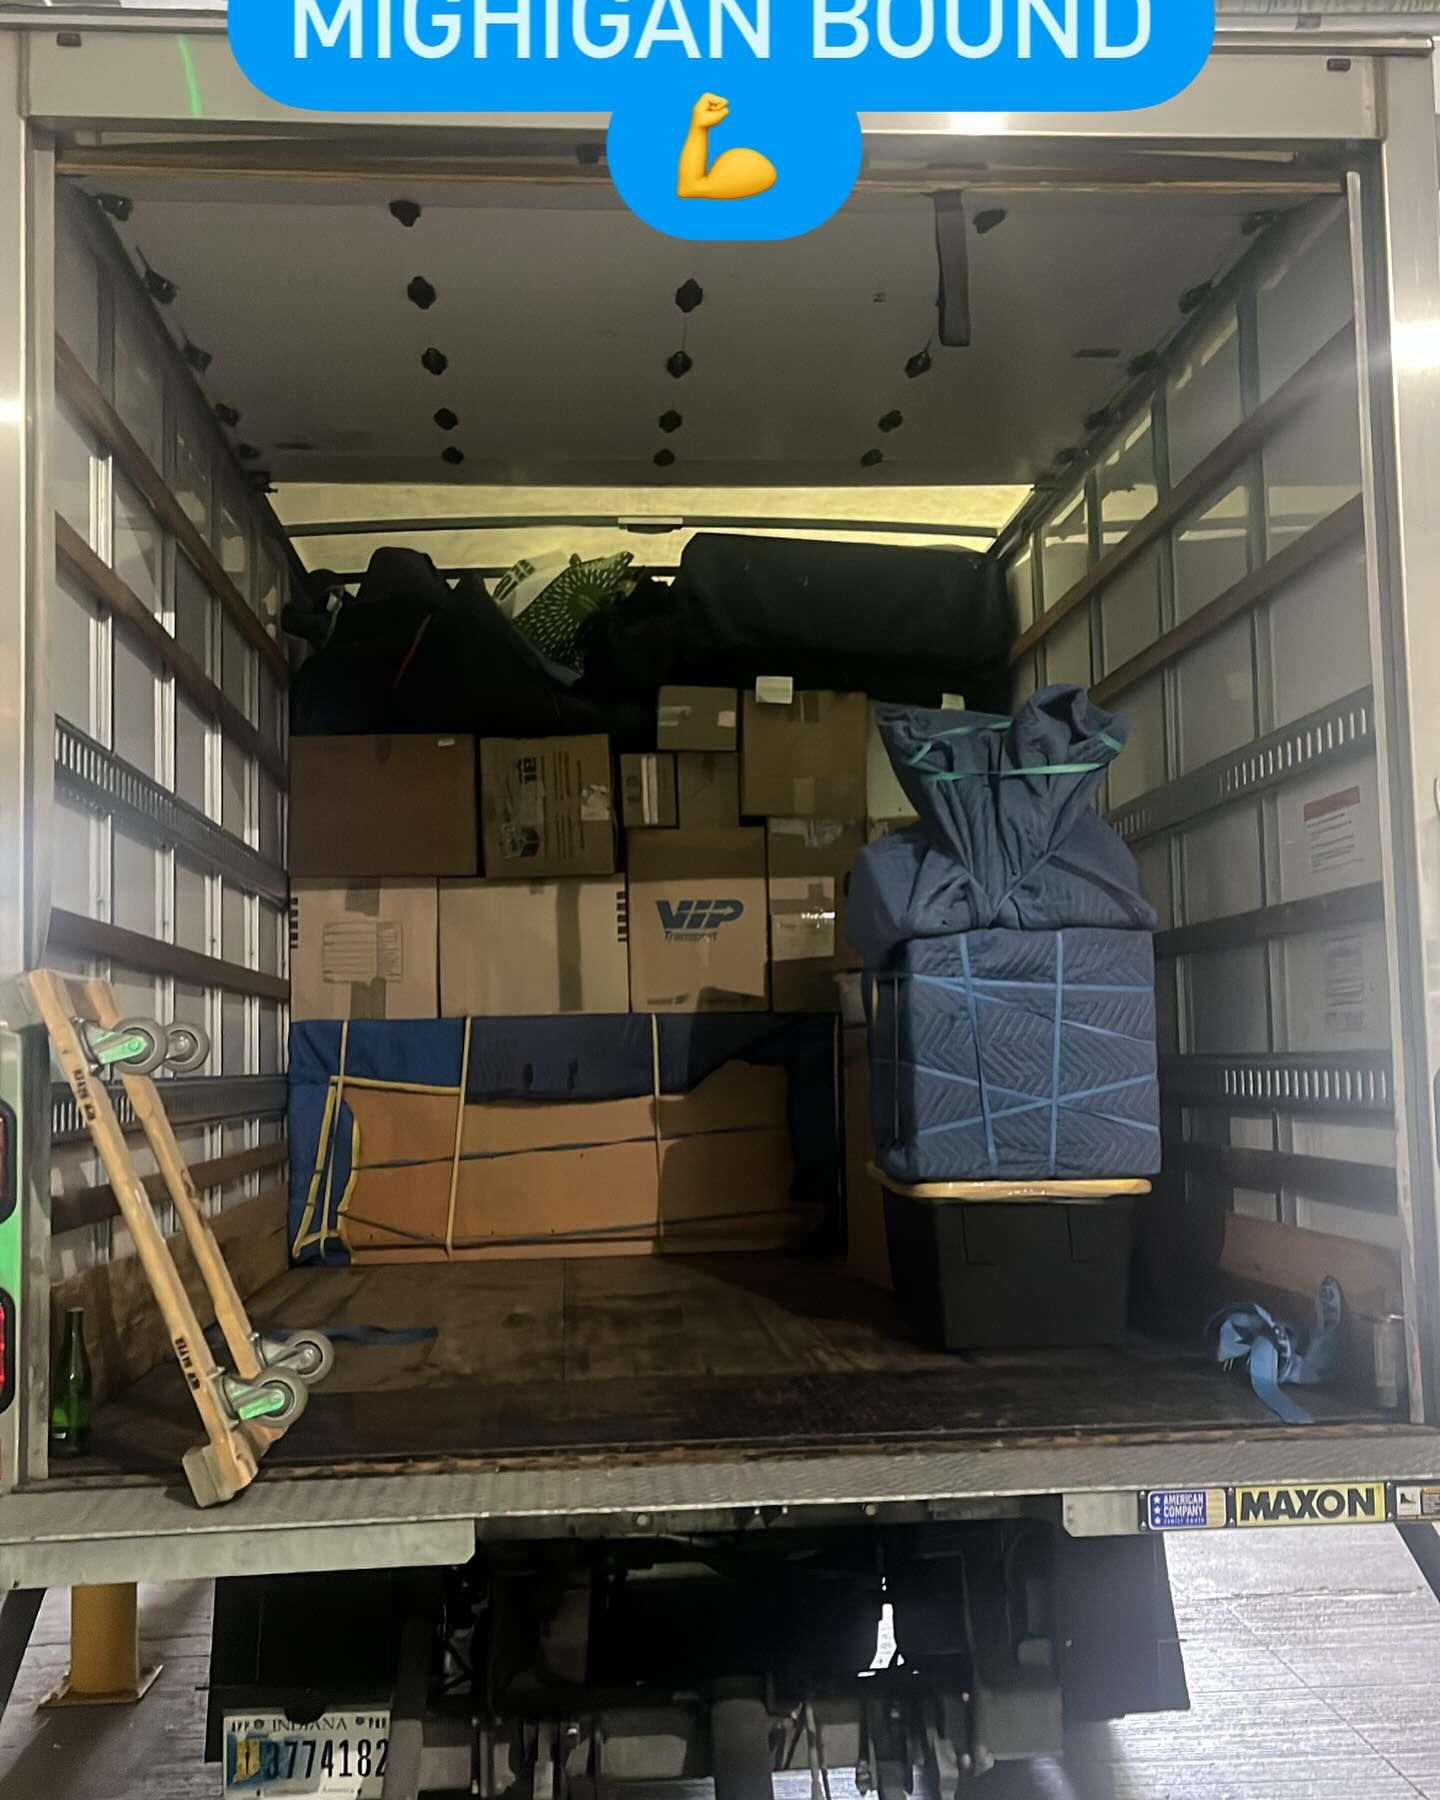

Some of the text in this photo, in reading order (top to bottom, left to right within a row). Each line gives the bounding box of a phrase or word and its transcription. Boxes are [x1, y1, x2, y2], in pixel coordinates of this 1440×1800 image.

[656, 899, 744, 929] VIP
[1163, 1493, 1204, 1506] AMERICAN
[1240, 1487, 1376, 1522] MAXON
[1163, 1504, 1204, 1518] COMPANY
